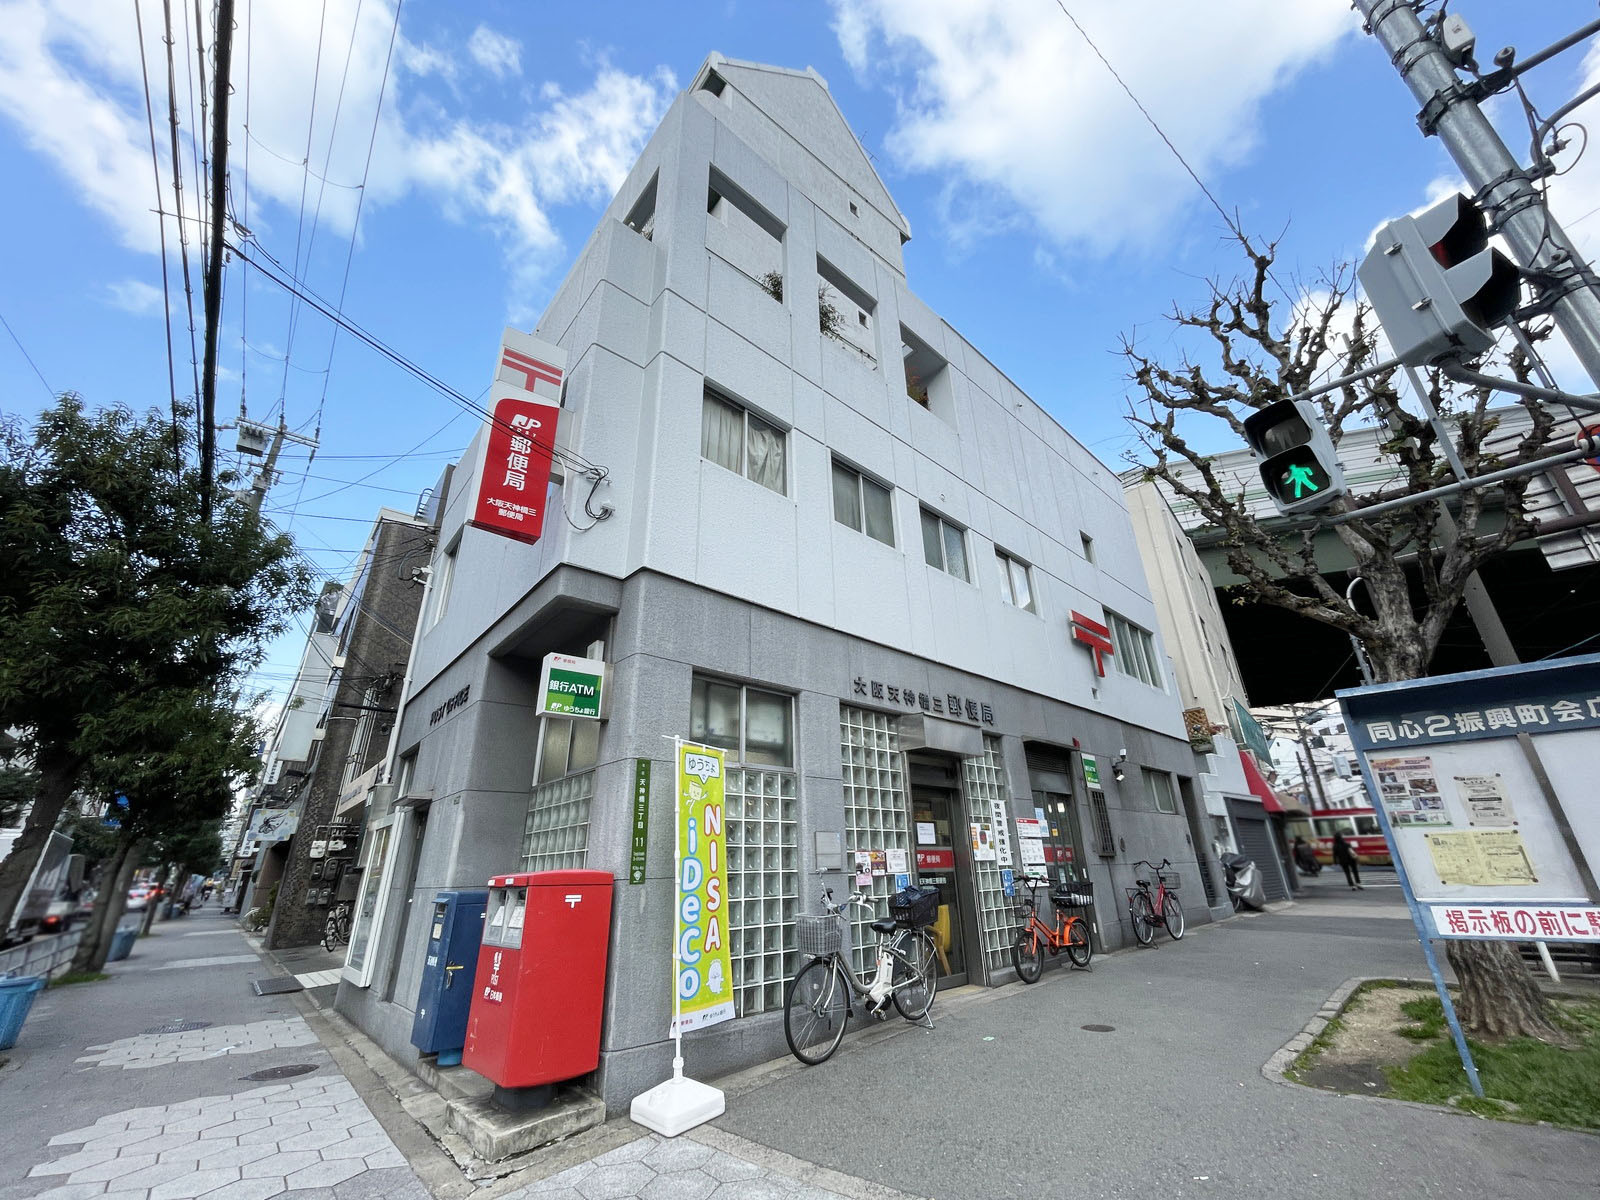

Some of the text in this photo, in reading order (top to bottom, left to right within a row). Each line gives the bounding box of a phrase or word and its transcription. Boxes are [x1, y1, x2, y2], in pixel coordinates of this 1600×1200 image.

[503, 434, 532, 491] 郵便局
[486, 497, 537, 517] 大阪天神橋三
[498, 507, 524, 521] 郵便局
[548, 679, 595, 696] 銀行ATM
[688, 757, 716, 774] ゆうちょ
[635, 837, 644, 848] 11
[704, 803, 722, 954] NISA
[680, 816, 704, 1001] iDeCo
